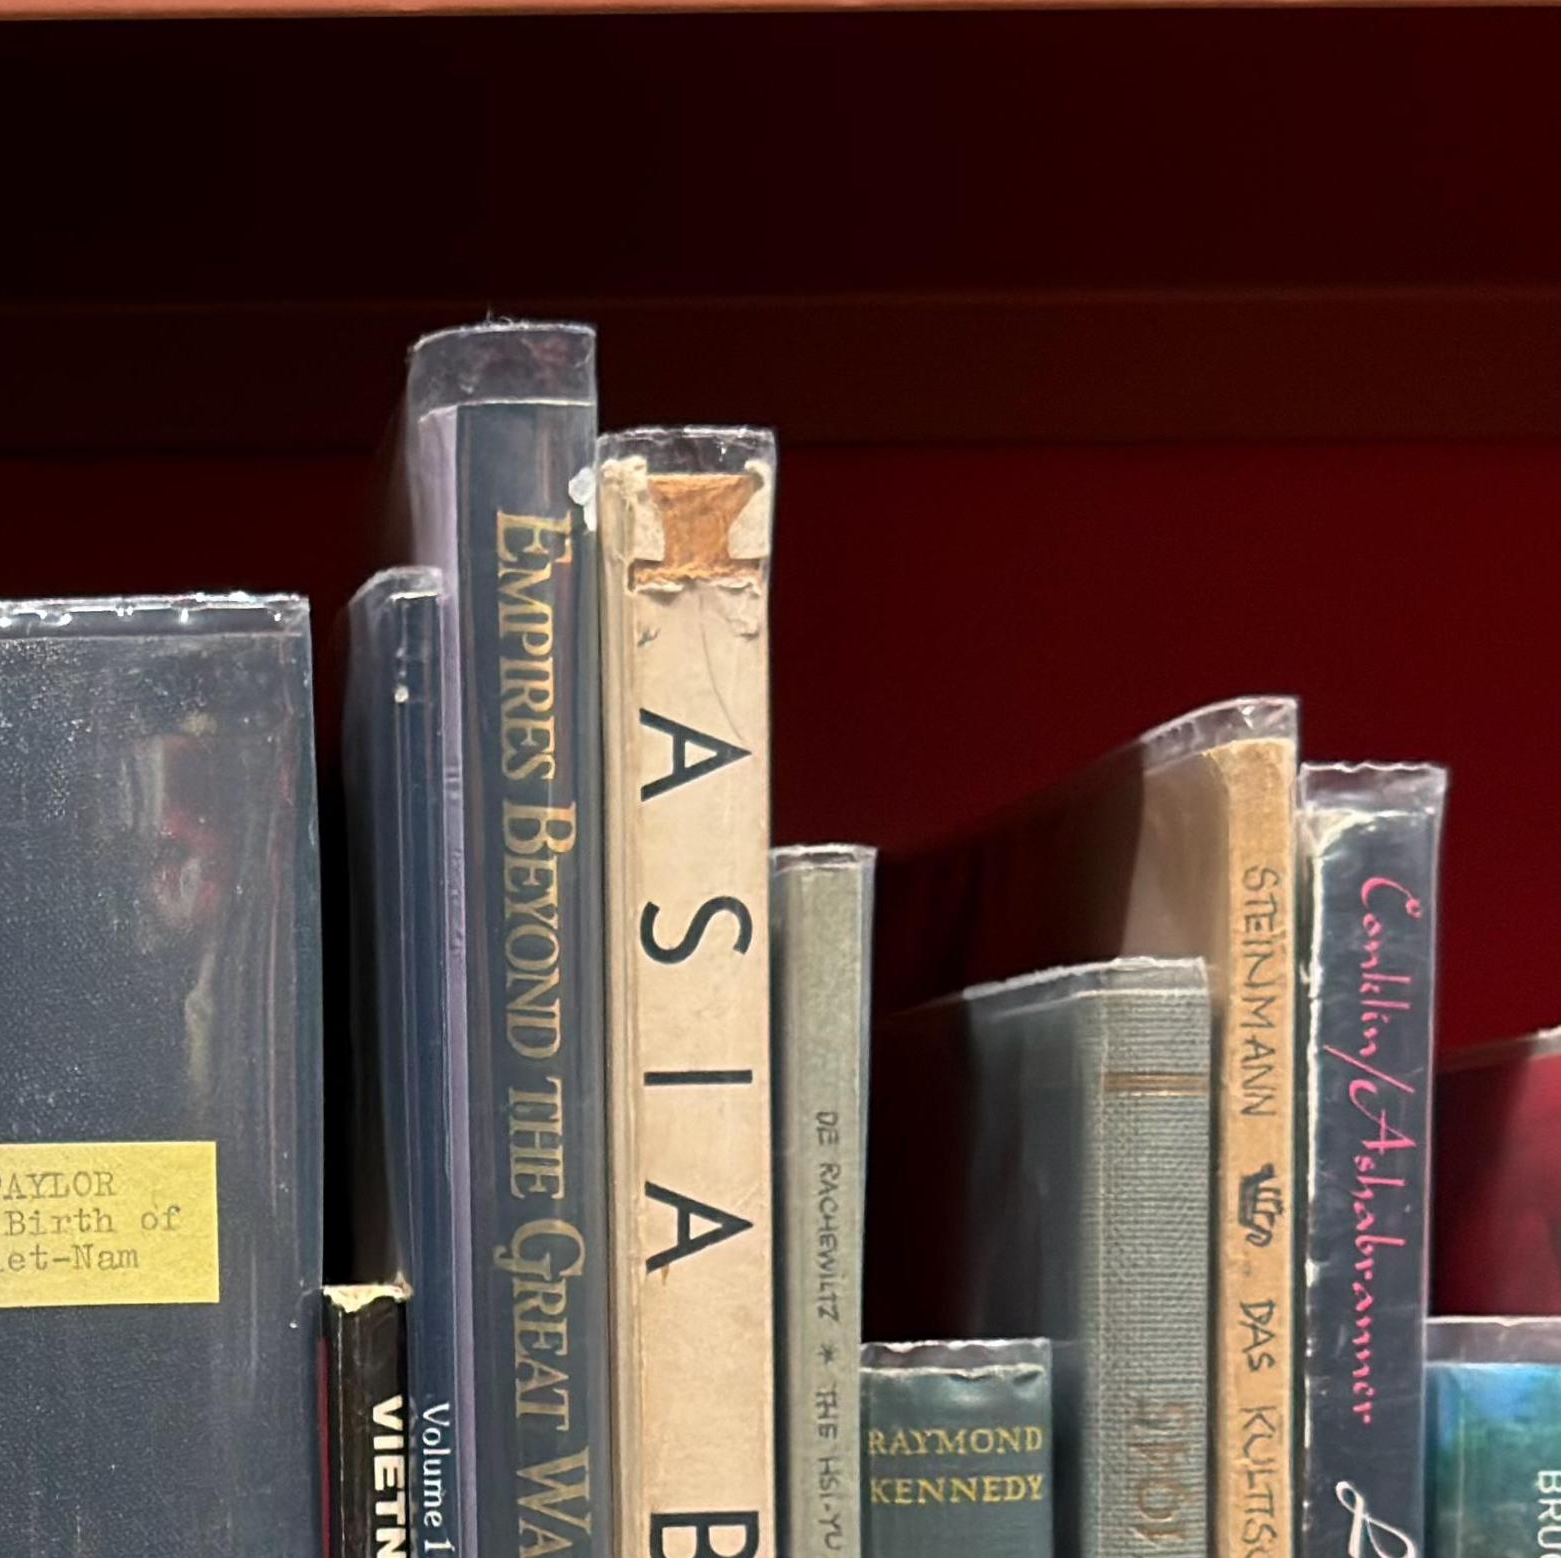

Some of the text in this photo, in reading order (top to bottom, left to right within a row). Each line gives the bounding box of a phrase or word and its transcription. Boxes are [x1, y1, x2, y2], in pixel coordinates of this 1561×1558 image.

[637, 705, 756, 1277] ASIA
[1241, 866, 1280, 1117] STEINMANN
[815, 1112, 840, 1146] DE
[4, 1208, 116, 1237] Birth
[140, 1205, 182, 1232] of
[1238, 1299, 1277, 1373] DAS
[421, 1399, 455, 1529] Volume
[868, 1426, 1043, 1456] RAYMOND
[870, 1473, 1044, 1504] KENNEDY
